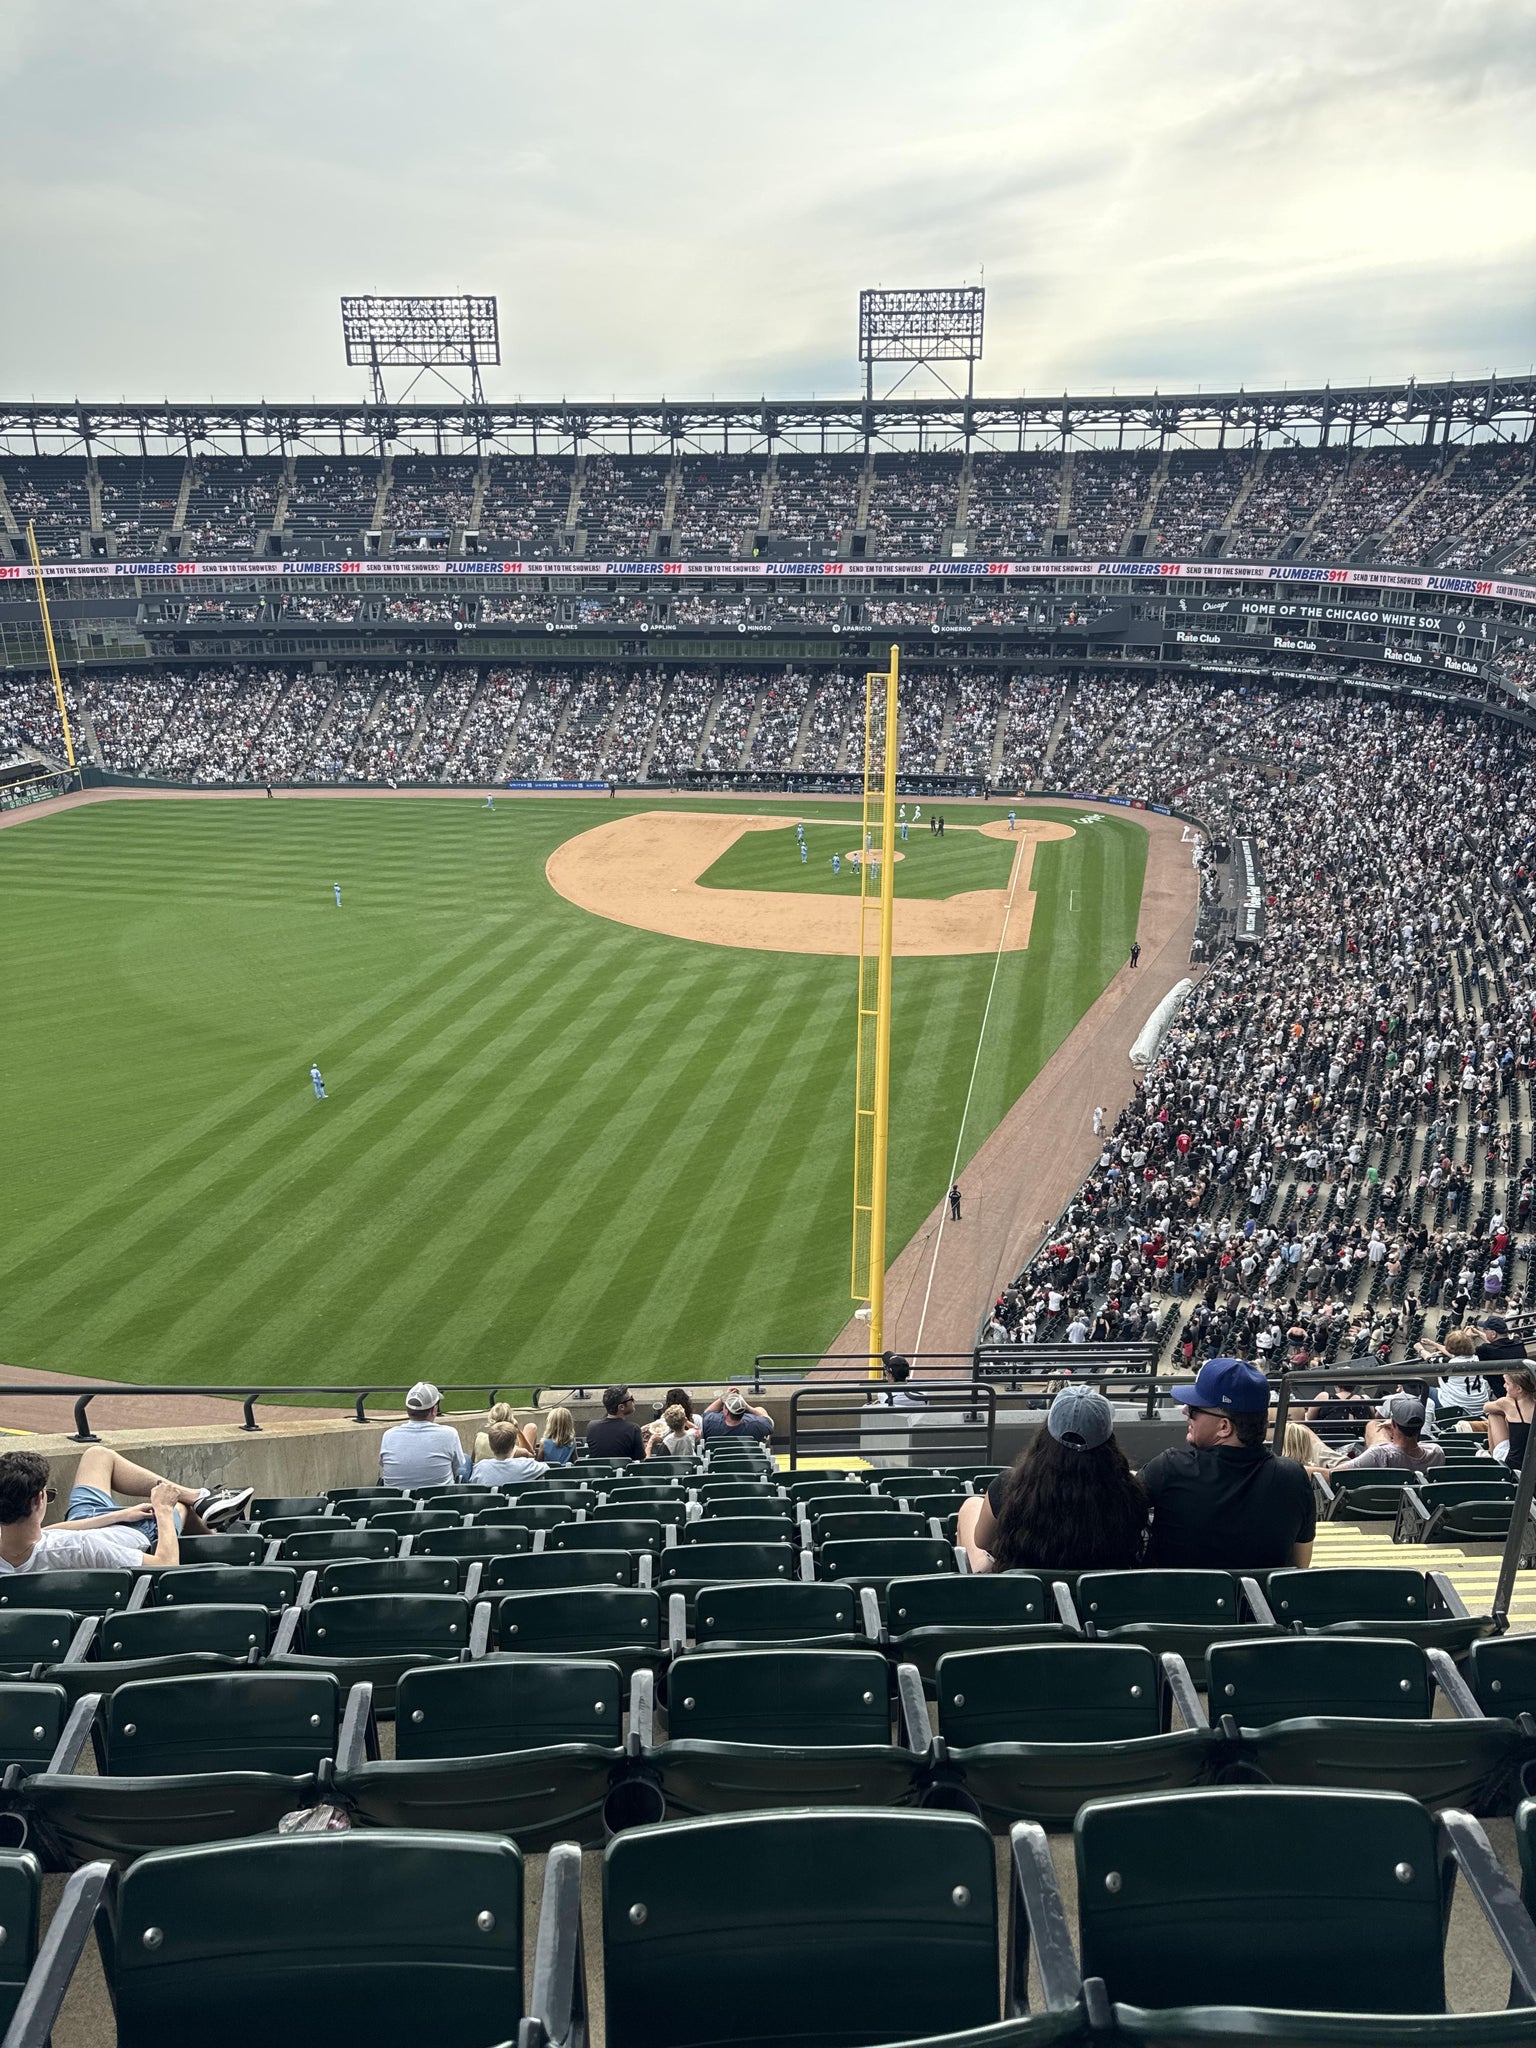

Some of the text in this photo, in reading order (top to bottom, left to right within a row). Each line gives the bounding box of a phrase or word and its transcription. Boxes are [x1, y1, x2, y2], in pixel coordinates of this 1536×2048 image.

[115, 564, 196, 574] PLUMBERS911
[283, 563, 360, 573] PLUMBERS911
[446, 563, 522, 573] PLUMBERS911
[606, 564, 682, 573] PLUMBERS911
[766, 564, 843, 574] PLUMBERS911
[929, 564, 1008, 573] PLUMBERS911
[1098, 564, 1180, 574] PLUMBERS911
[1269, 568, 1348, 582] PLUMBERS911
[1427, 577, 1492, 594] PLUMBERS911
[1203, 601, 1229, 612] Chicago
[1242, 604, 1441, 629] HOME OF THE CHICAGO WHITE SOX
[1177, 632, 1220, 643] Rate Club
[1274, 637, 1316, 650] Rate Club
[1384, 648, 1422, 664] Rate Club
[1445, 656, 1478, 673] Rate Club
[1464, 1375, 1481, 1395] 14
